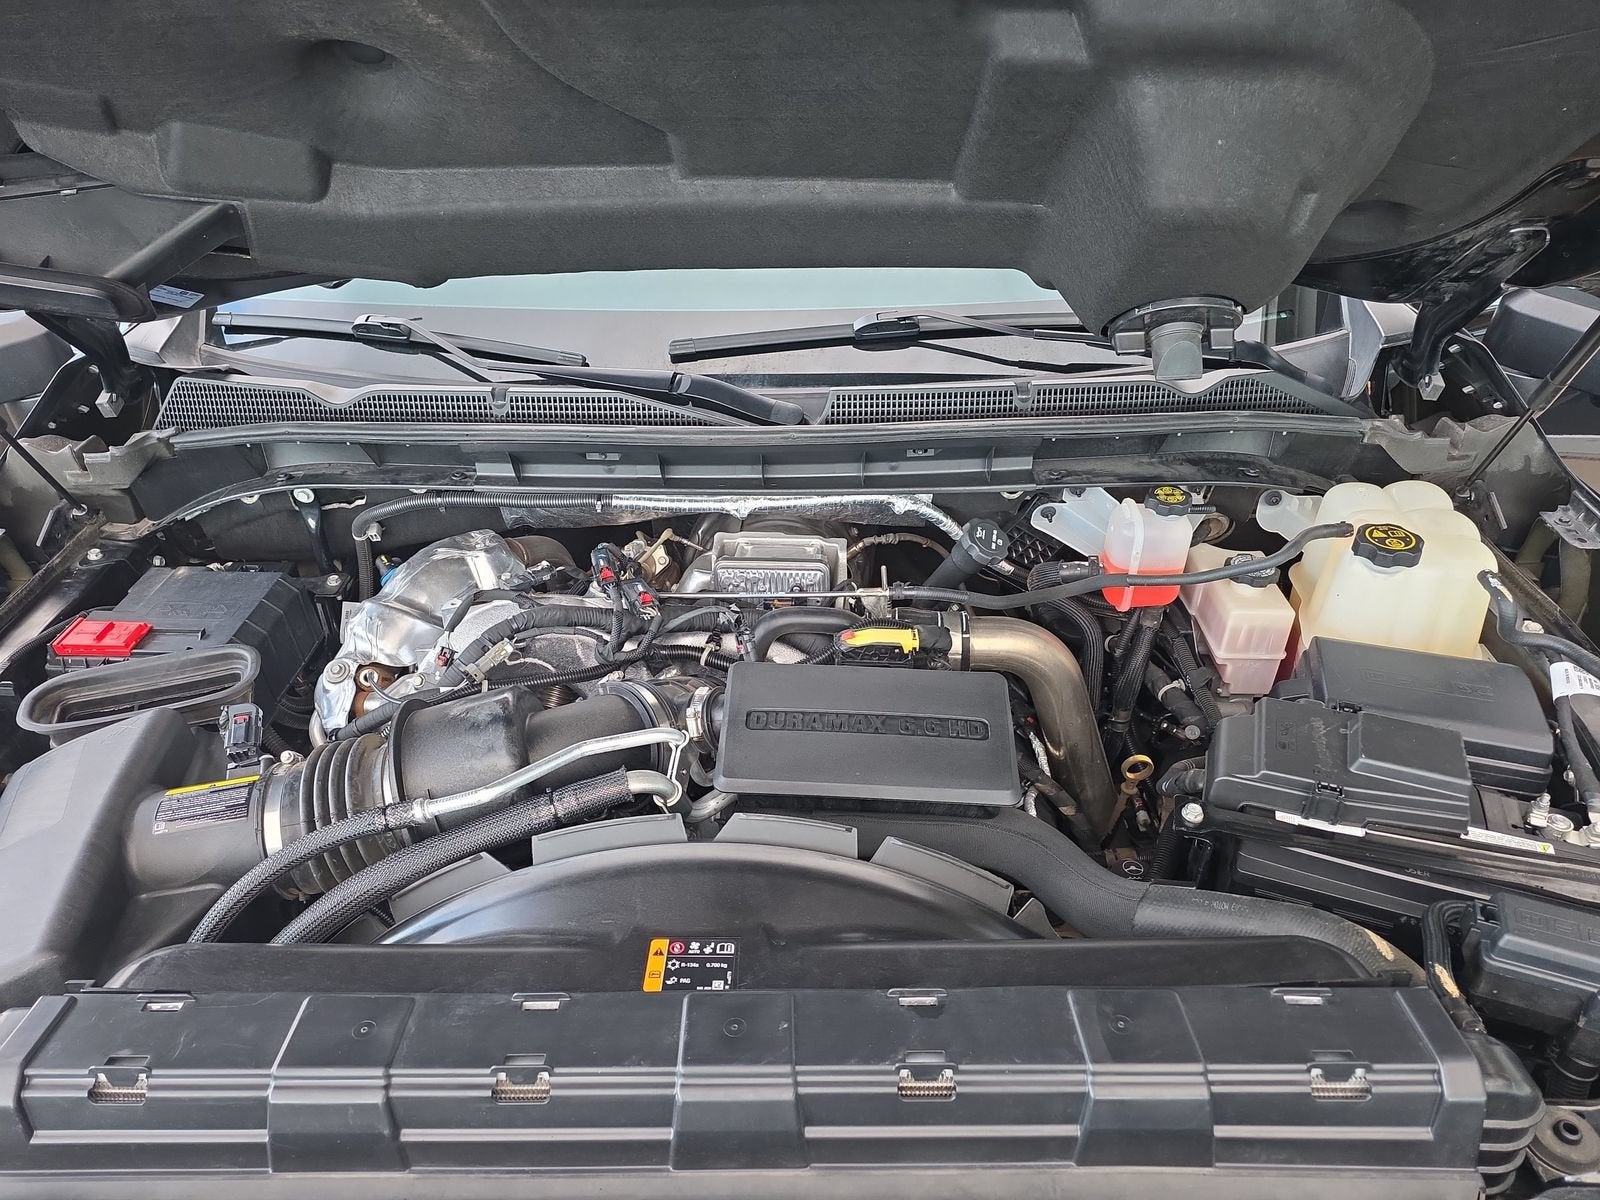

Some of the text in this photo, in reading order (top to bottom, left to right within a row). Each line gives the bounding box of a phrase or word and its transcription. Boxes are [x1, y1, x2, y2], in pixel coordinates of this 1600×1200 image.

[749, 711, 987, 739] DURAMAX 6.6 HD
